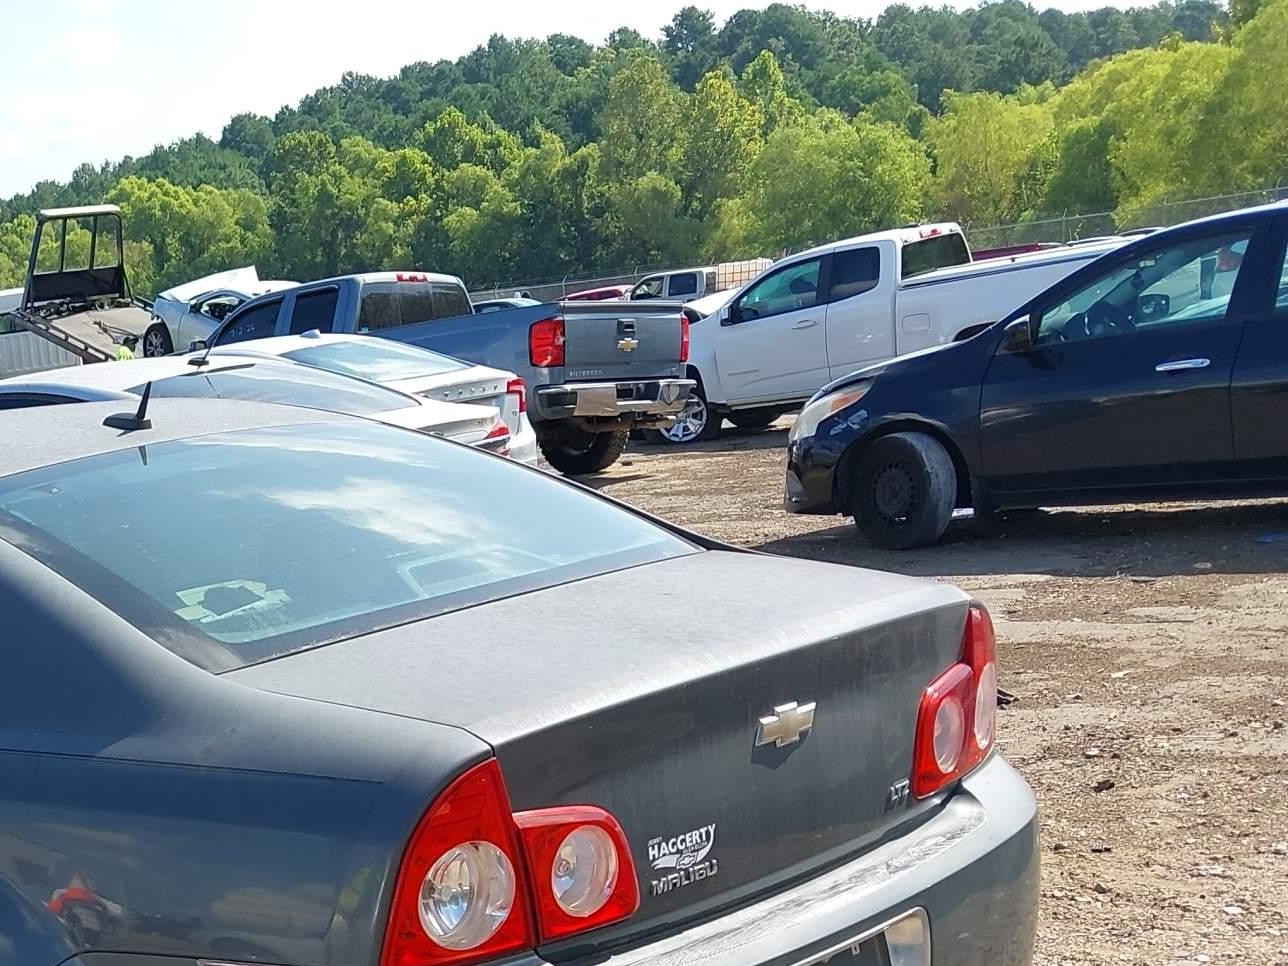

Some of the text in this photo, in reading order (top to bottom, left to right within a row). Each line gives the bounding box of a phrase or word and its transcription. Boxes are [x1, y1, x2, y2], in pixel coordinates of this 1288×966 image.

[889, 780, 910, 800] LTZ
[648, 823, 716, 861] HAGGERTY
[651, 858, 718, 897] MALIBU
